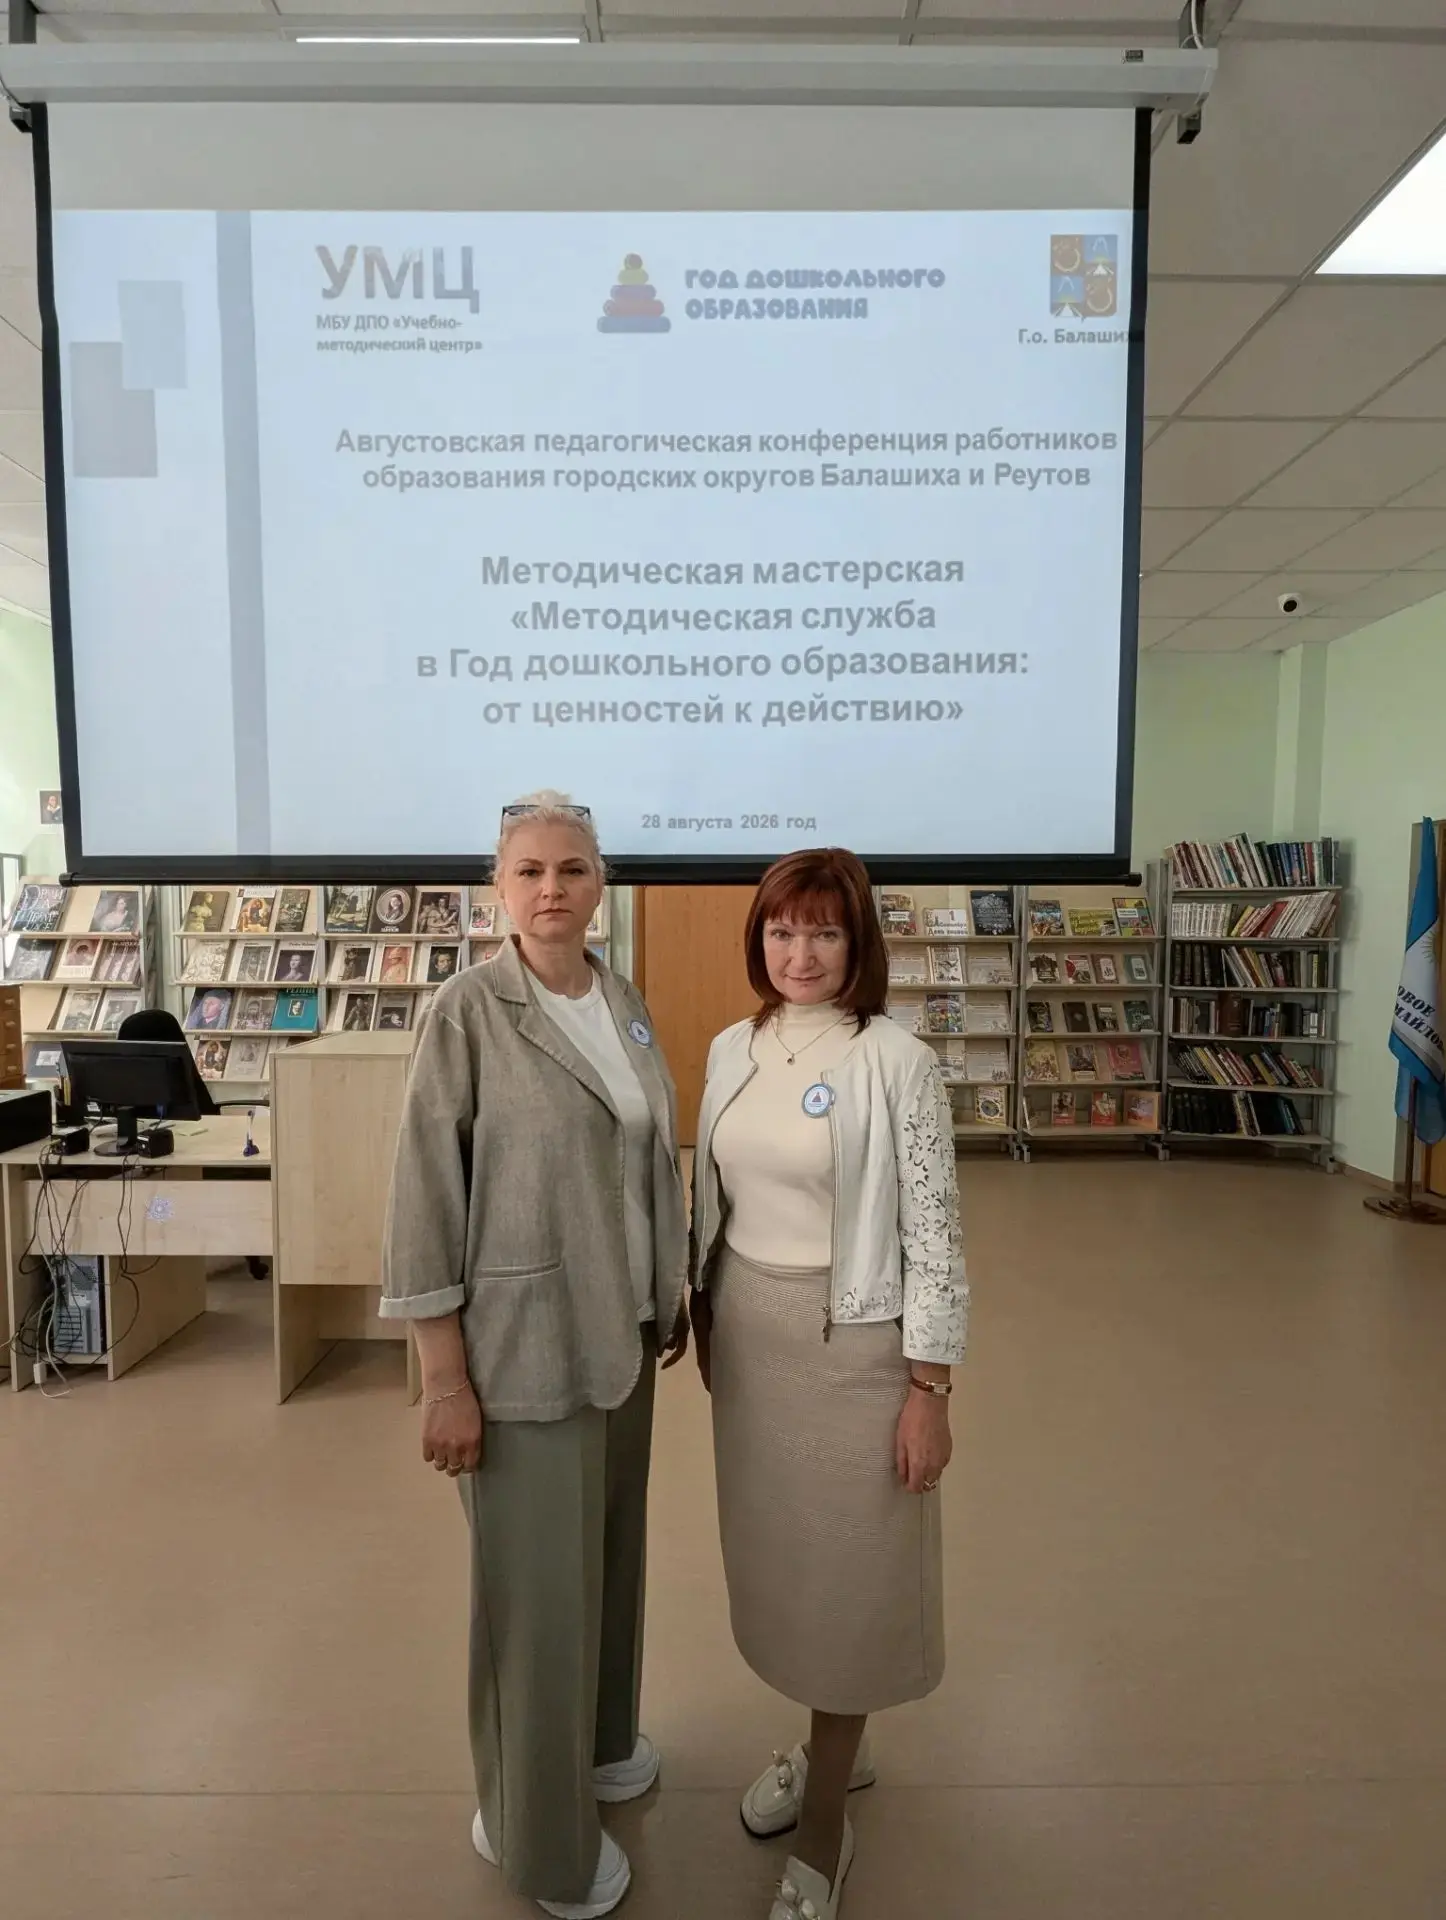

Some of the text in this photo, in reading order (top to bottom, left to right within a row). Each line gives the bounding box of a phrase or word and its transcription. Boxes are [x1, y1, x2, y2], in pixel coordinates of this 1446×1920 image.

[314, 243, 481, 315] УМЦ
[684, 267, 946, 290] ГОД ДОШКОЛЬНОГО
[316, 314, 463, 333] МБУ ДПО «Учебно-
[684, 297, 869, 320] ОБРАЗОВАНИЯ
[316, 336, 483, 354] методический центр»
[1018, 327, 1130, 345] Г.о. Балаши
[335, 426, 1117, 459] Августовская педагогическая конференция работников
[362, 462, 1091, 494] образования городских округов Балашиха и Реутов
[482, 555, 964, 590] Методическая мастерская
[511, 598, 936, 637] «Методическая служба
[417, 644, 1028, 683] в Год дошкольного образования:
[482, 692, 964, 728] от ценностей к действию»
[641, 813, 817, 833] 28 августа 2026 год
